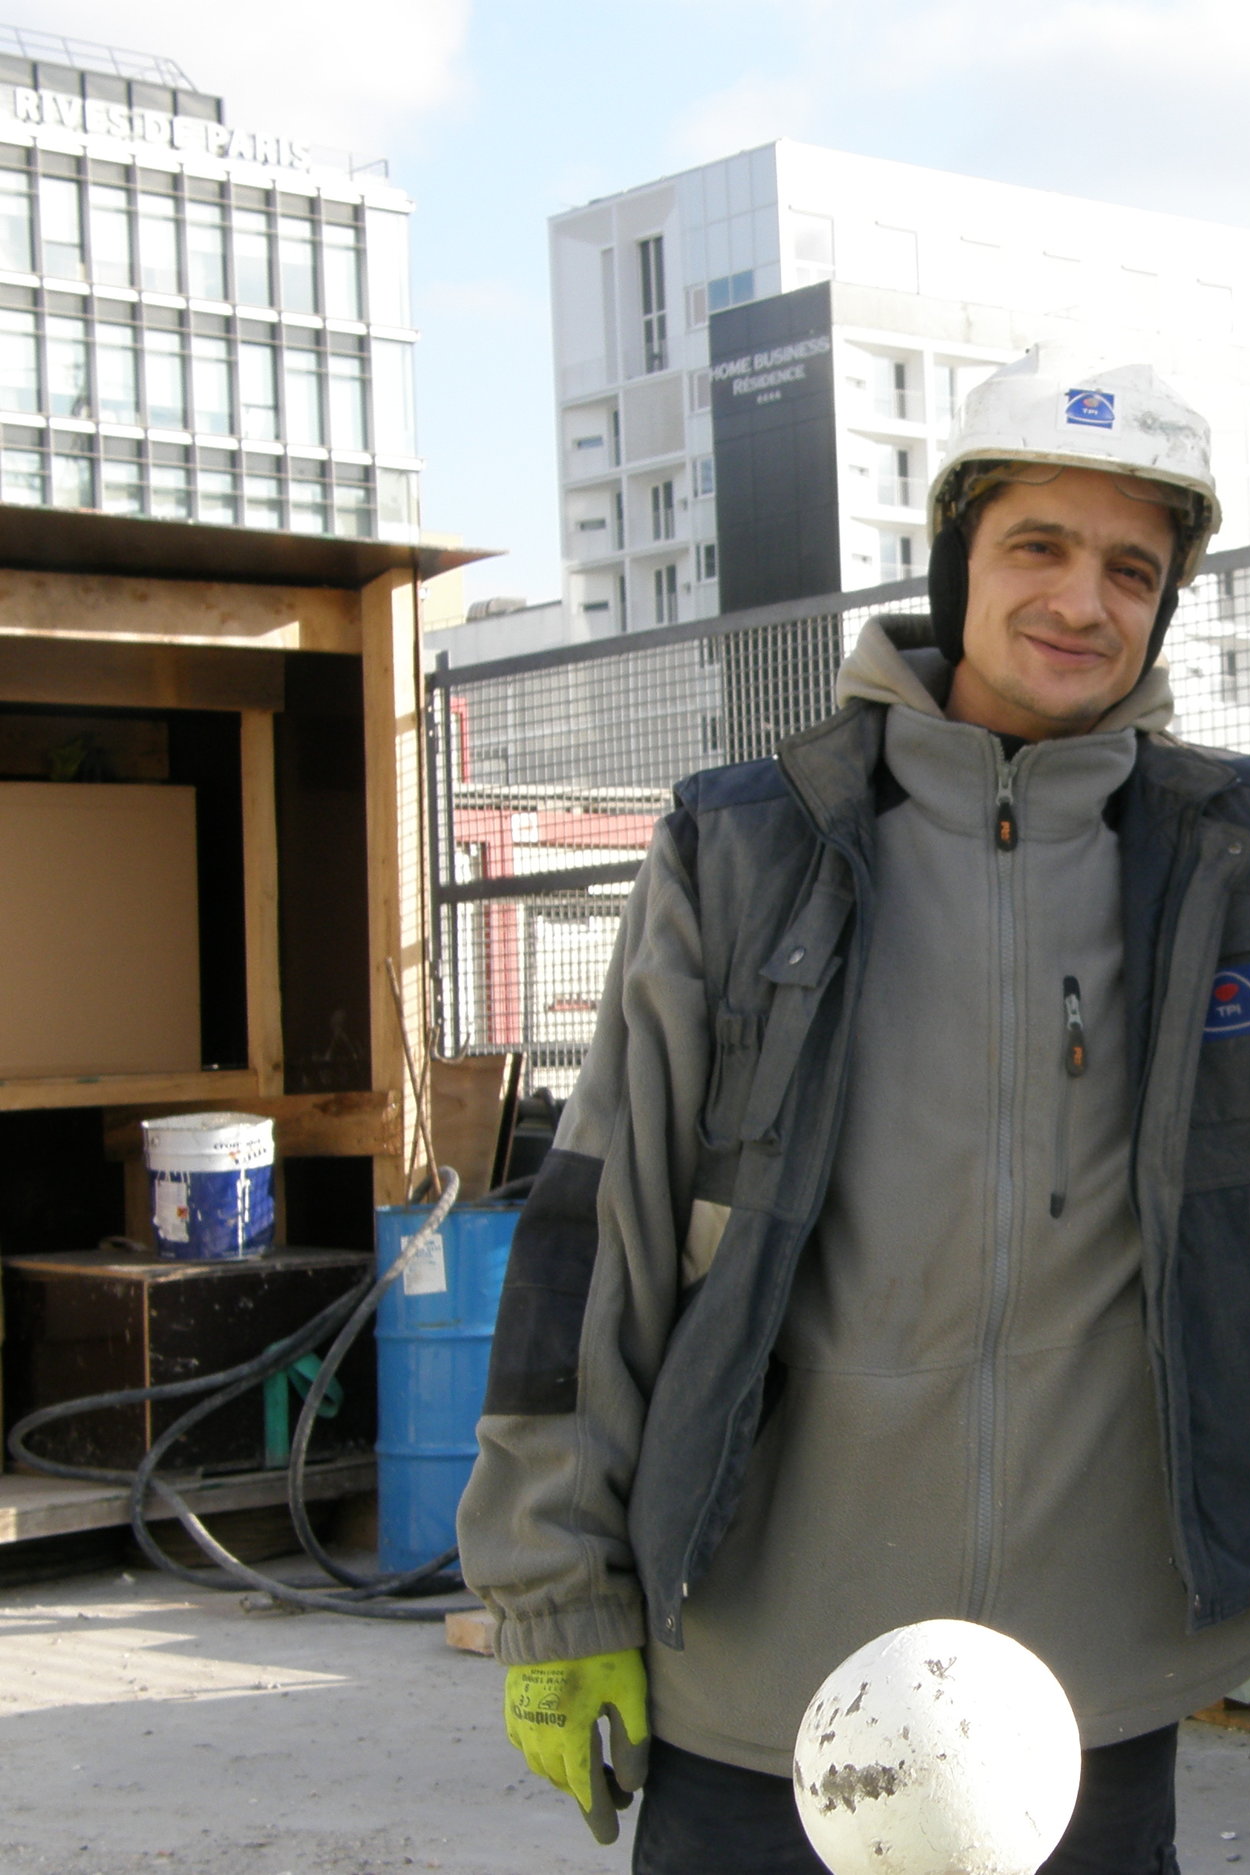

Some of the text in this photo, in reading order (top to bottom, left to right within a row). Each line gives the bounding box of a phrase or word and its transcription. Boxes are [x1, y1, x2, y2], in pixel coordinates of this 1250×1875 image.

[14, 86, 131, 140] RIVES
[206, 121, 312, 171] PARIS
[711, 335, 830, 382] HOME BUSINESS
[1215, 1003, 1243, 1018] TPI
